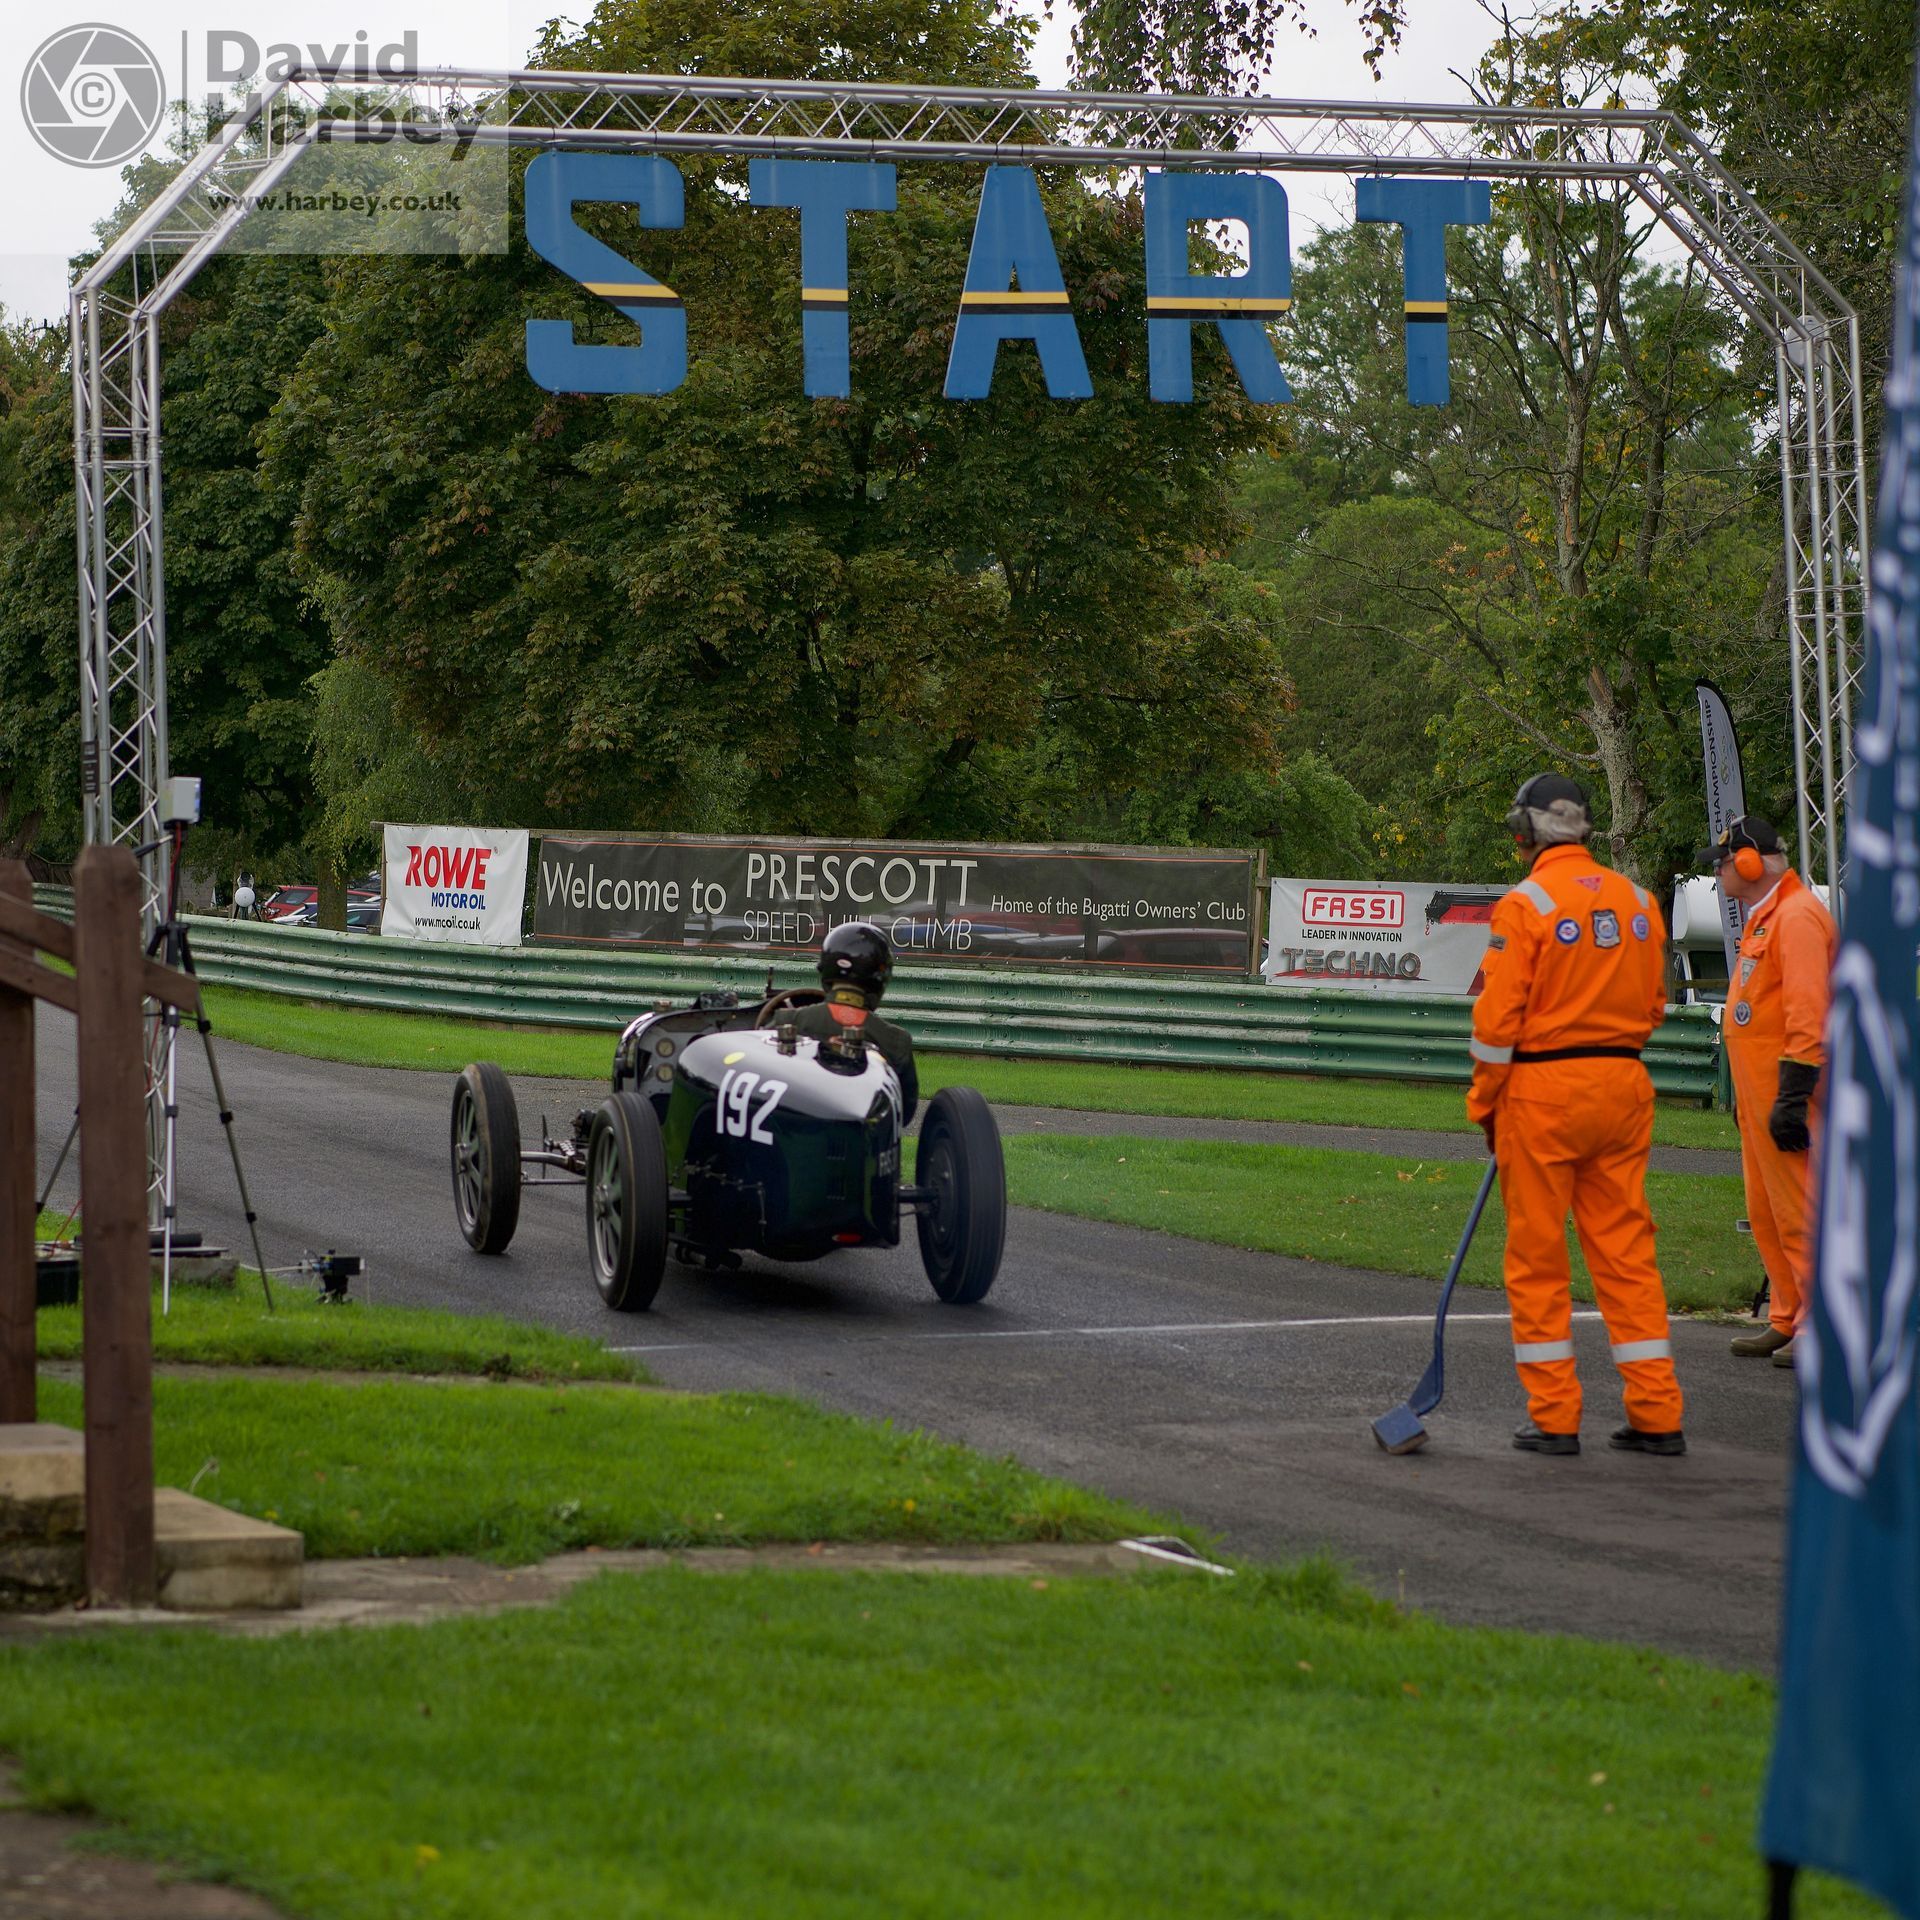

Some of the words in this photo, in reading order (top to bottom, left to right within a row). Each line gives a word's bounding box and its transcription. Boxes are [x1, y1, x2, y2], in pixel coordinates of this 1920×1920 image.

[524, 152, 1491, 405] START
[1704, 699, 1723, 835] CHAMPIONSHIP
[405, 845, 491, 890] ROWE
[542, 861, 680, 913] Welcome
[691, 876, 727, 915] to
[746, 853, 978, 907] PRESCOTT
[415, 915, 481, 930] www.mcoil.co.uk
[990, 895, 1033, 913] Home
[1038, 896, 1052, 914] of
[1056, 897, 1078, 915] the
[1083, 898, 1130, 921] Bugatti
[1207, 902, 1246, 920] Club
[1311, 896, 1395, 920] FASSI
[743, 910, 815, 944] SPEED
[891, 916, 973, 951] CLIMB
[1302, 929, 1336, 940] LEADER
[1338, 931, 1347, 940] IN
[1349, 931, 1402, 942] INNOVATION
[1283, 947, 1422, 978] TECHNO
[716, 1069, 788, 1146] 192
